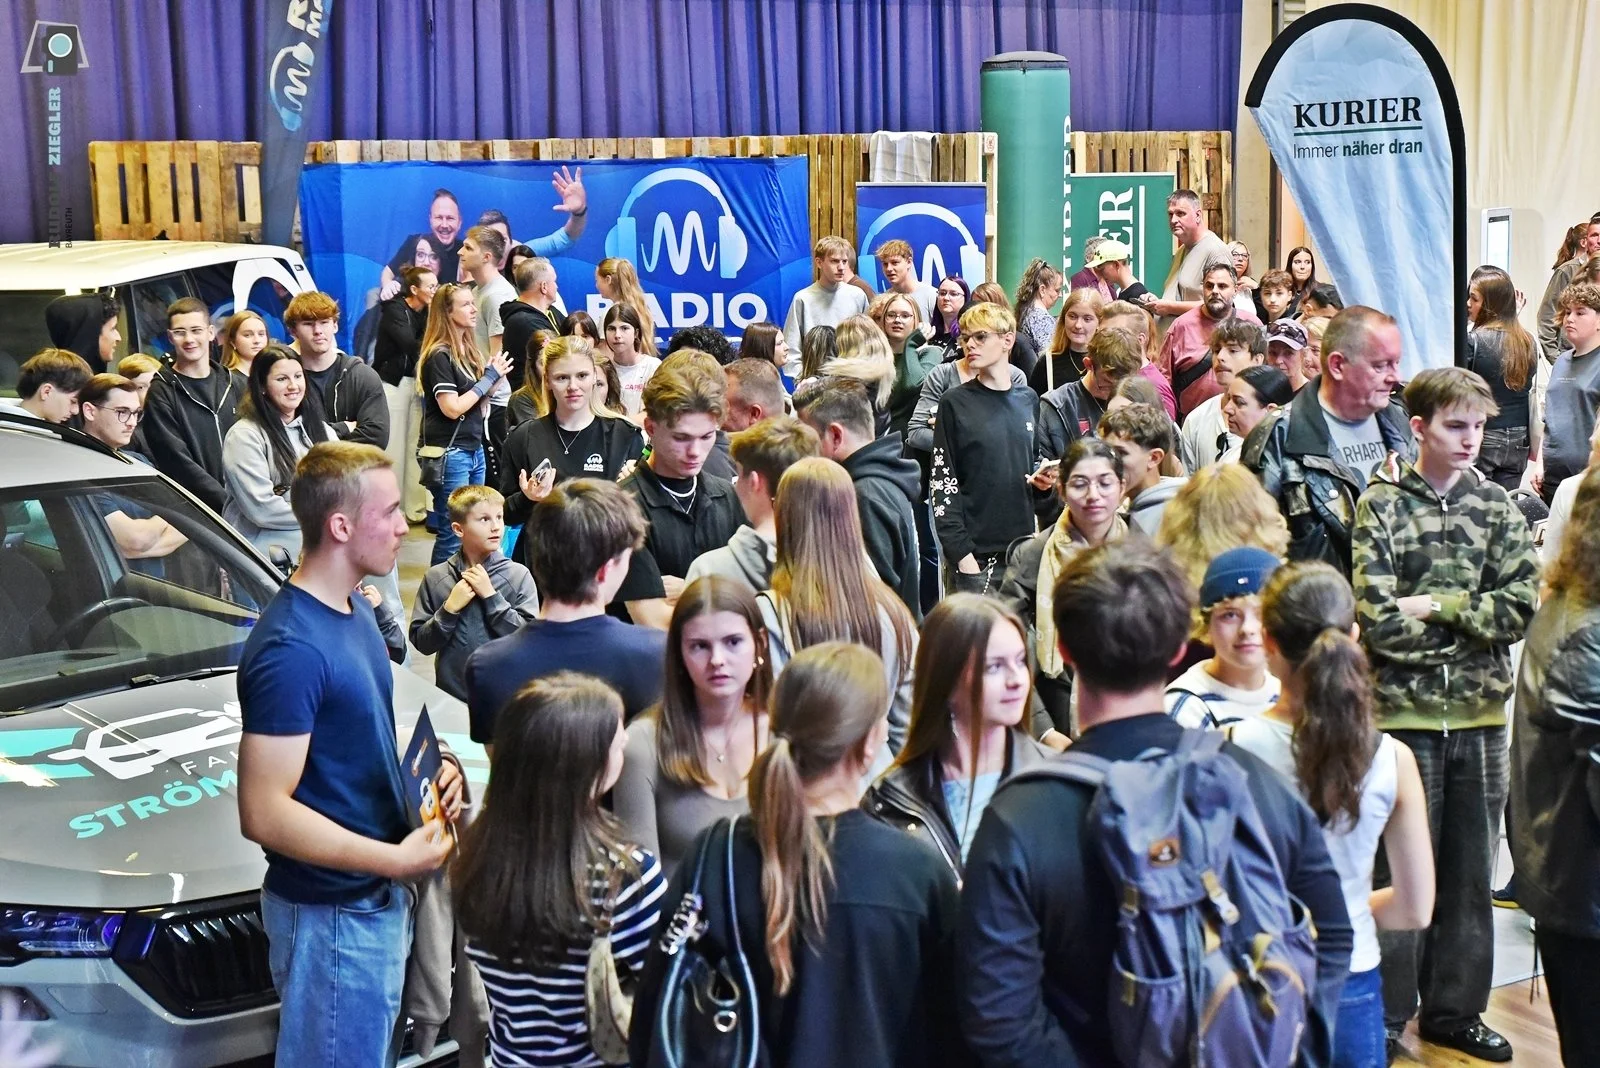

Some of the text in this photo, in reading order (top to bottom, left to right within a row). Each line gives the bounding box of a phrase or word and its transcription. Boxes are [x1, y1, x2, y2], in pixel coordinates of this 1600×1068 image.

[1293, 96, 1423, 129] KURIER
[1293, 138, 1423, 159] Immer näher dran
[181, 750, 239, 776] FA
